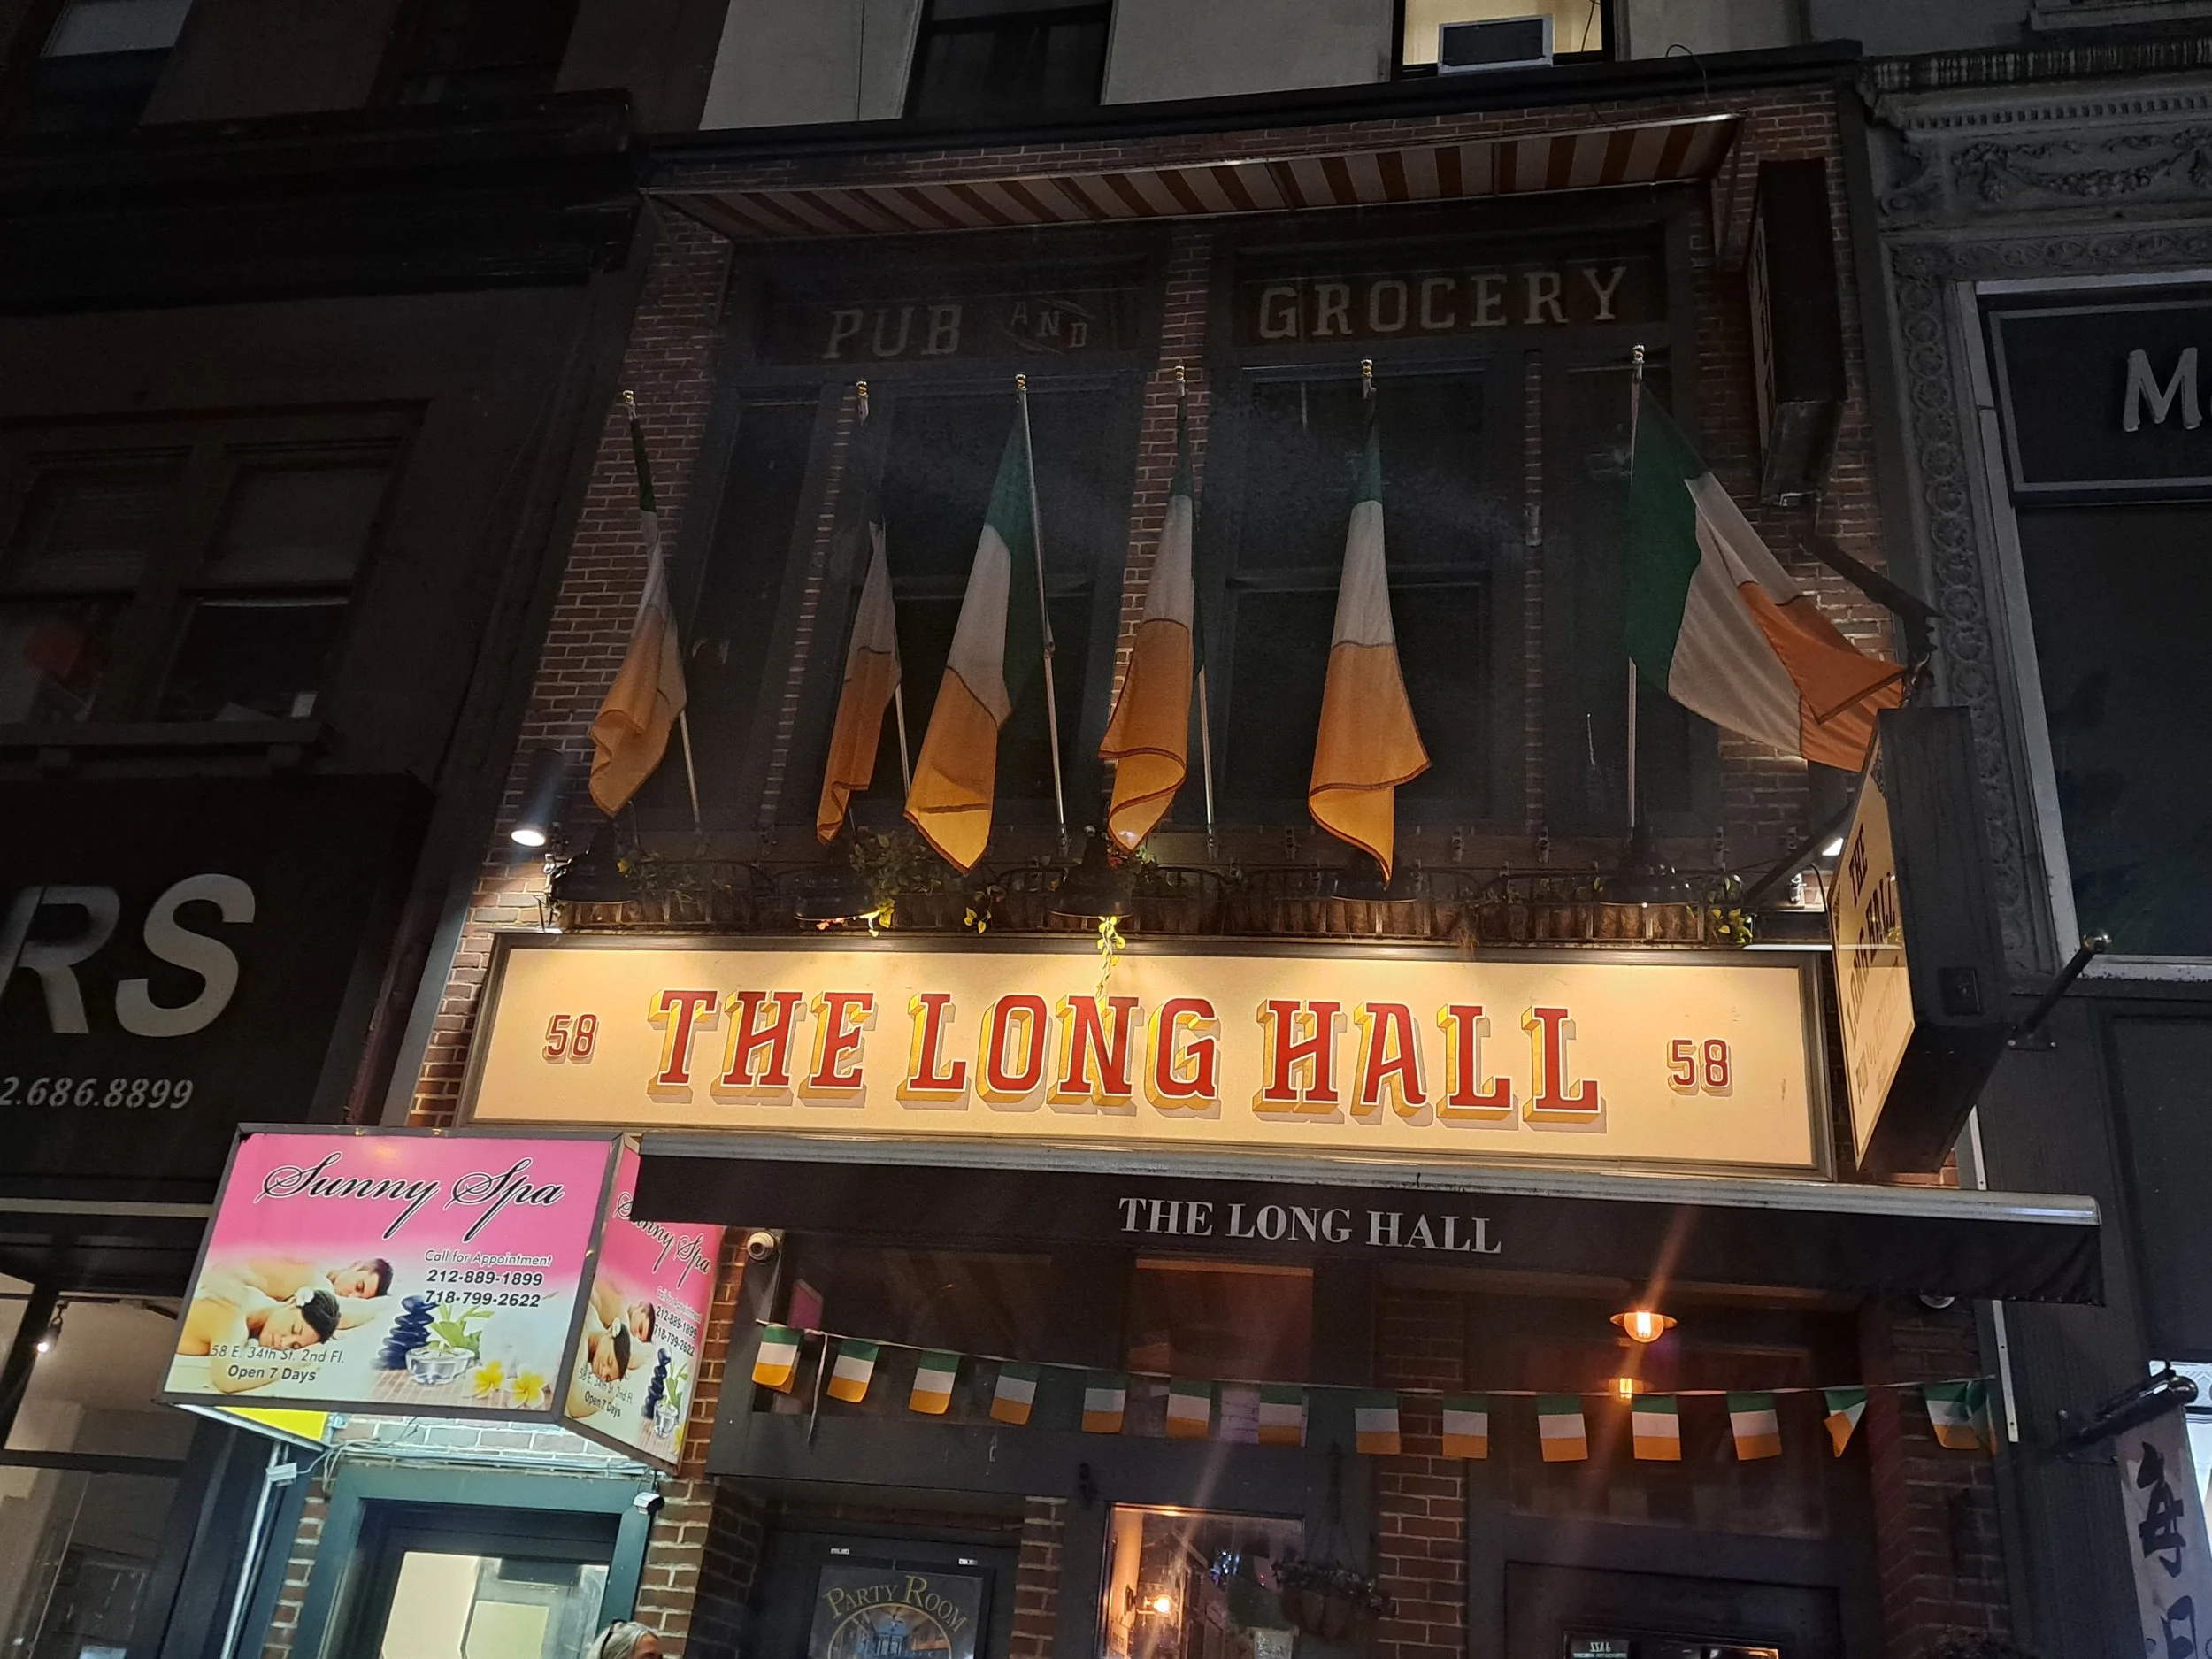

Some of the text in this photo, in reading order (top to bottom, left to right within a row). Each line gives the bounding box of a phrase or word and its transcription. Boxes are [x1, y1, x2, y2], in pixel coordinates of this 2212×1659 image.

[821, 265, 1628, 360] PUB AND GROCERY
[2124, 346, 2212, 433] M
[1848, 822, 1869, 910] THE
[0, 872, 256, 1038] RS
[545, 1014, 596, 1061] 58
[652, 989, 1605, 1126] THE LONG HALL
[1669, 1038, 1732, 1092] 58
[255, 1151, 565, 1243] Sunny Spa
[1118, 1196, 1502, 1255] THE LONG HALL
[425, 1249, 553, 1267] Call for Appointment
[426, 1269, 543, 1286] 212-889-1899
[673, 1233, 710, 1289] Spa
[425, 1290, 541, 1308] 718-799-2622
[656, 1305, 698, 1339] 212-889-1899
[210, 1344, 228, 1357] 58
[247, 1346, 277, 1361] 34th
[301, 1348, 328, 1363] 2nd
[330, 1350, 345, 1363] Fl.
[654, 1324, 695, 1357] 718-799-2622
[227, 1364, 317, 1384] Open 7 Days
[584, 1390, 621, 1418] Open 7 Days
[822, 1574, 968, 1632] PARTY ROOM
